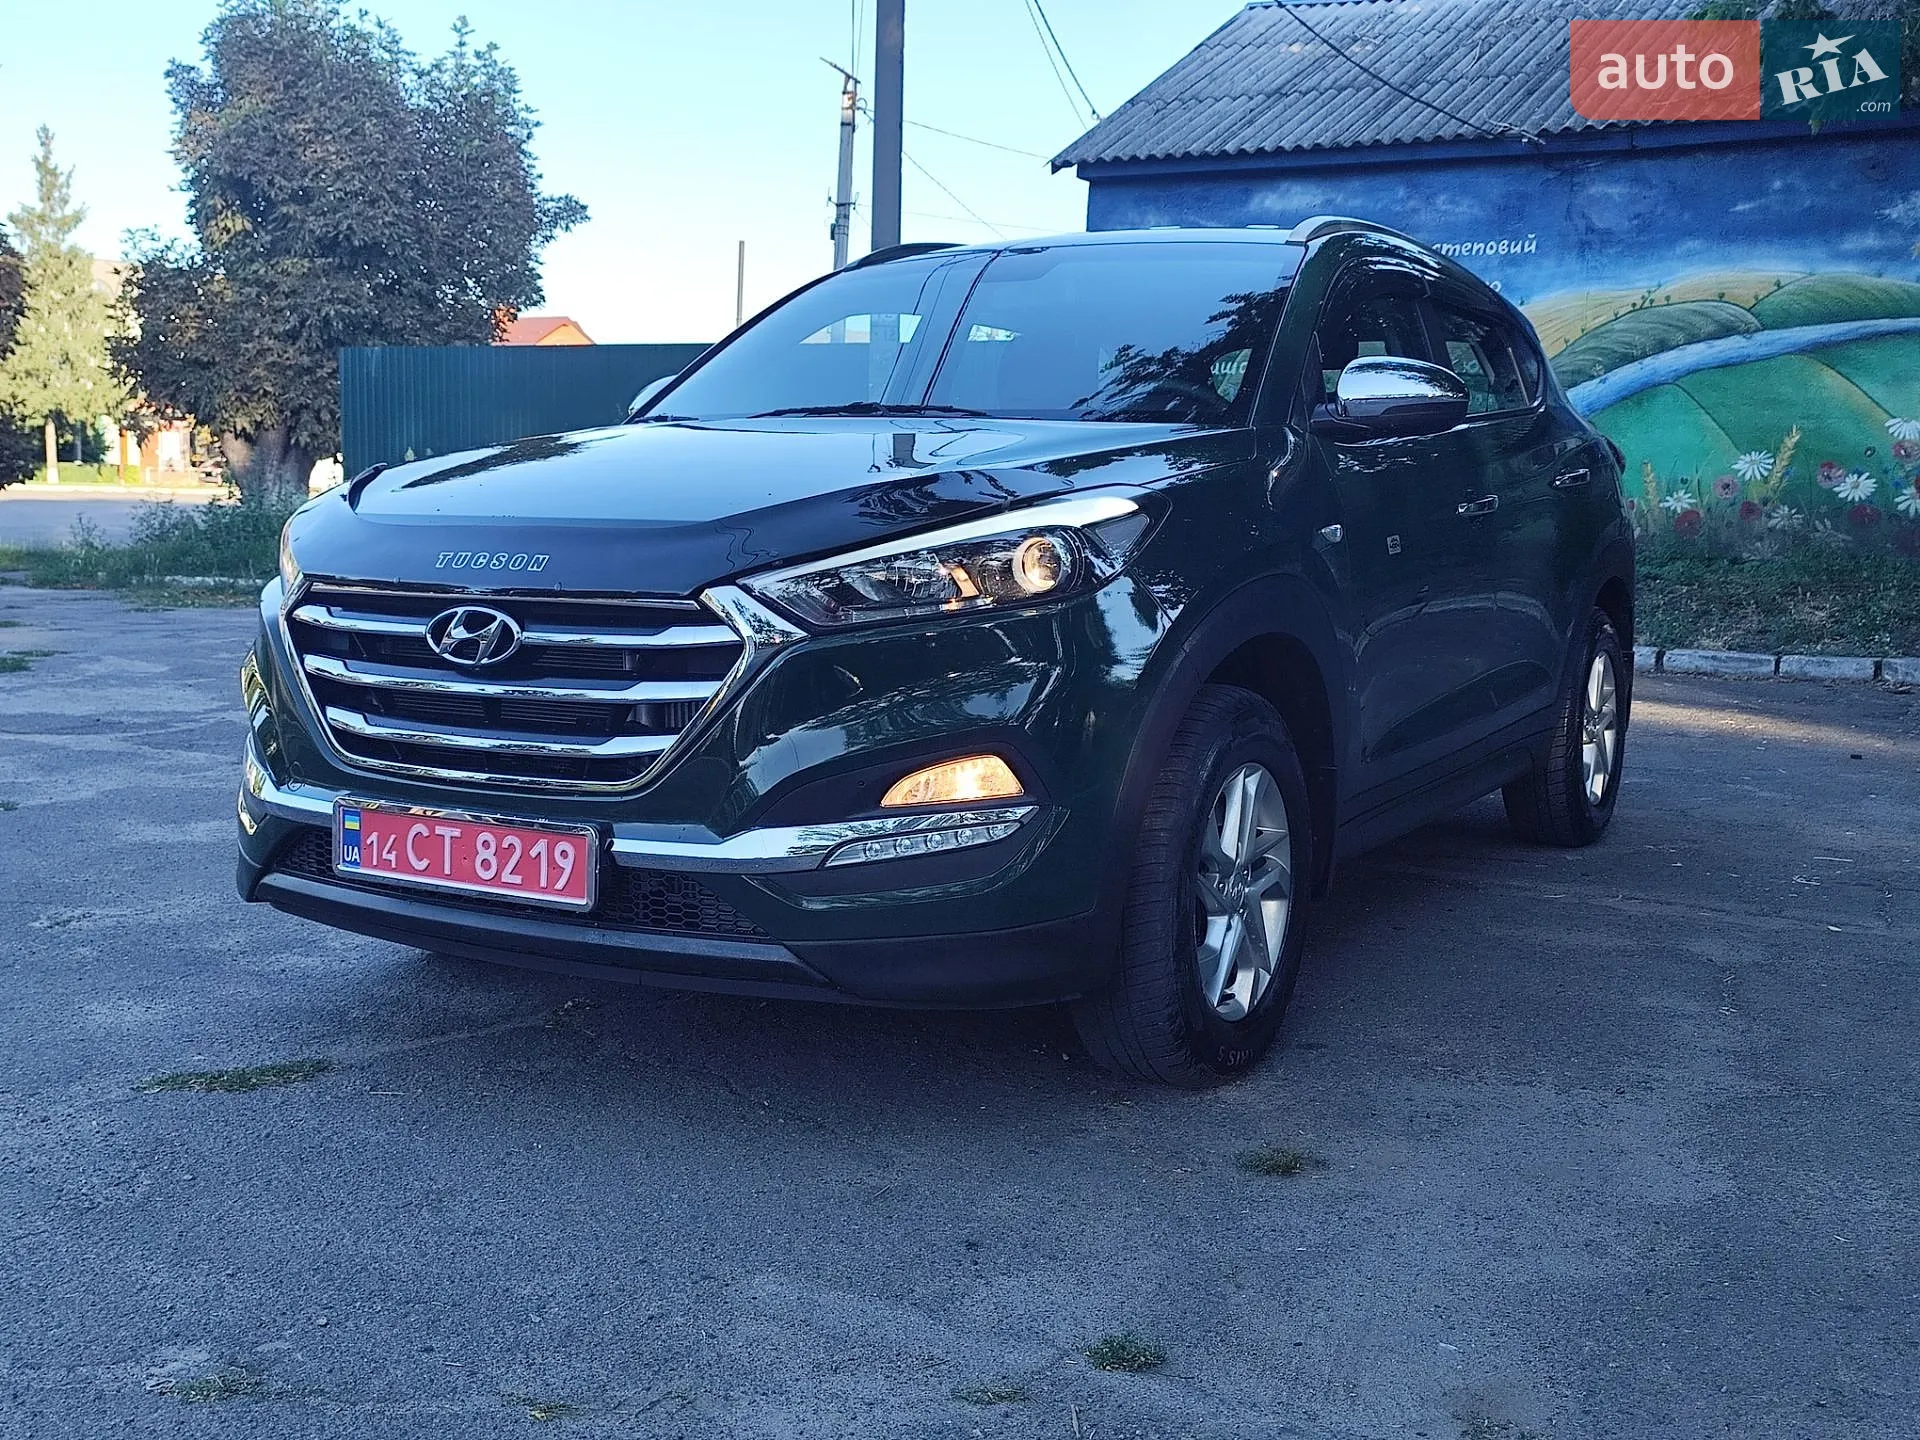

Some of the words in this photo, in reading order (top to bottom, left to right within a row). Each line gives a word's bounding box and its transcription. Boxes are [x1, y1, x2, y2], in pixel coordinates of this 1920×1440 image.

[435, 551, 550, 572] TUCSON
[344, 844, 361, 864] UA
[474, 831, 576, 891] 8219
